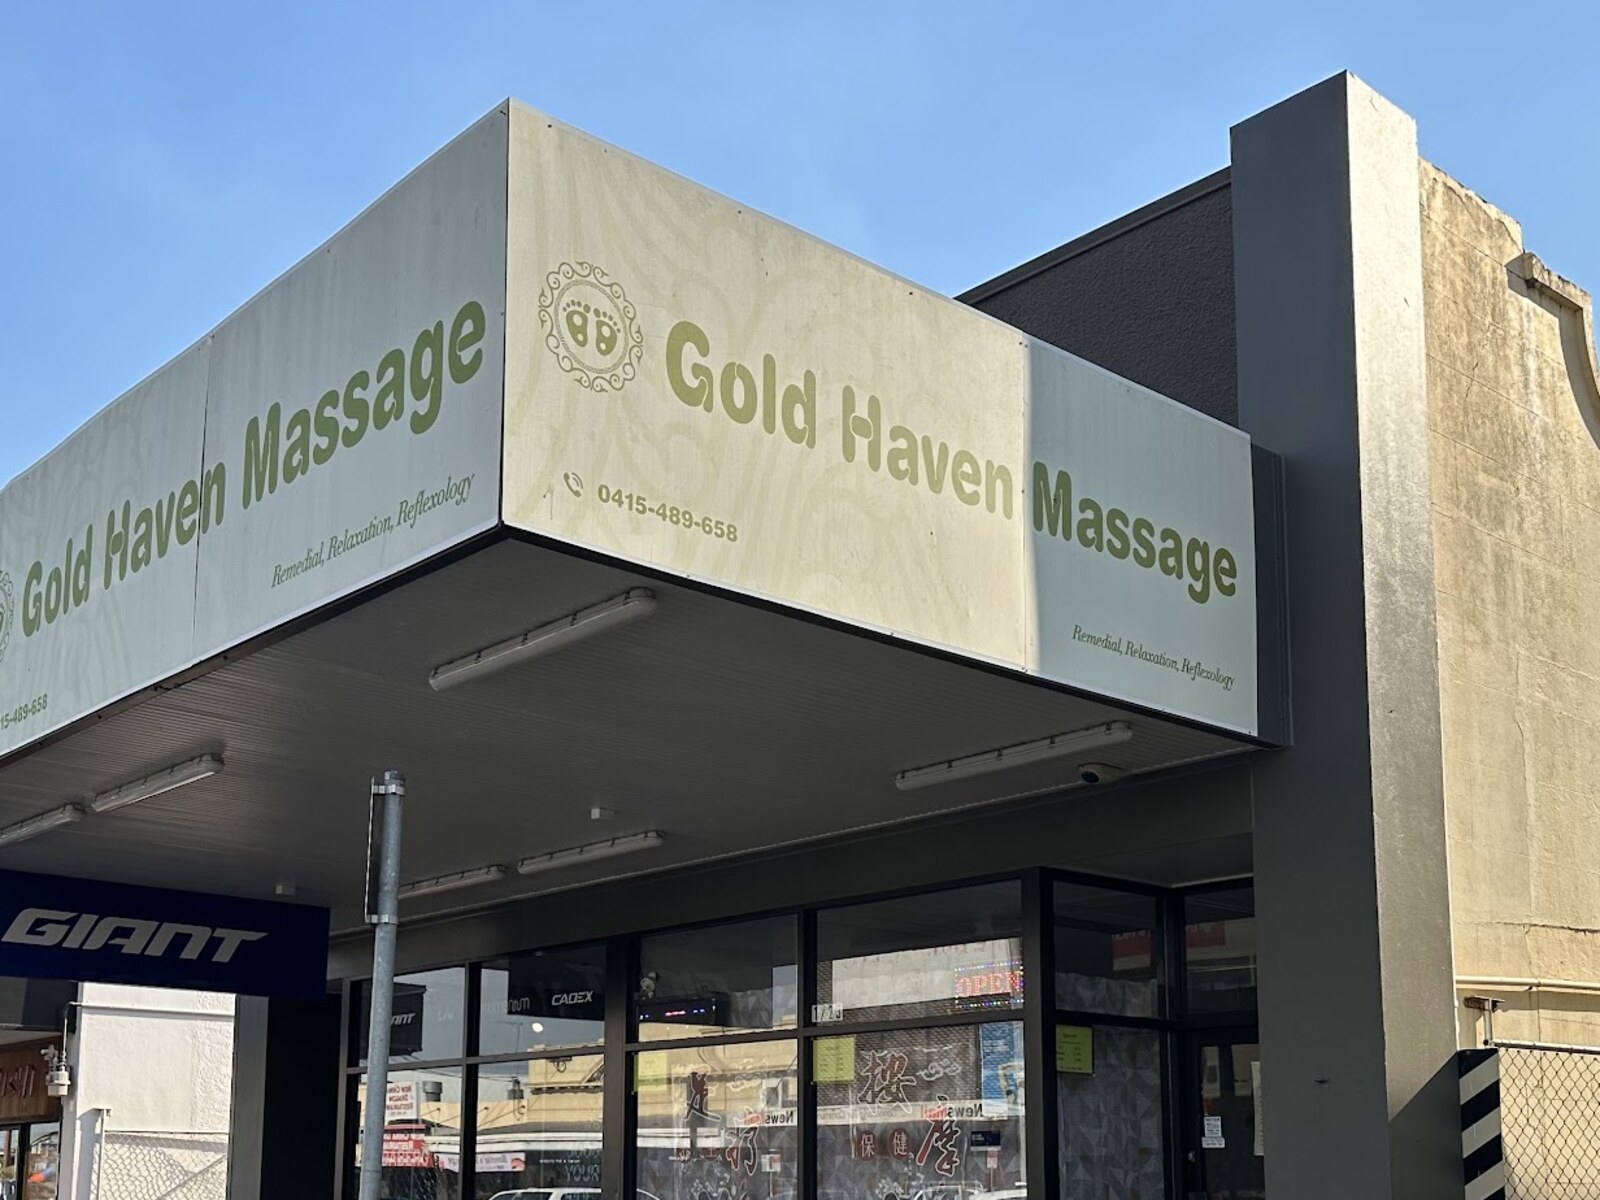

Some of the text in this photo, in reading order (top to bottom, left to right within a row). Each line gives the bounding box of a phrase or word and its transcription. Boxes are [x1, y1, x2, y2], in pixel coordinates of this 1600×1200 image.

[22, 300, 487, 637] Gold Haven Massage
[665, 320, 1238, 605] Gold Haven Massage
[271, 473, 476, 588] Remedial, Relaxation, Reflexology
[597, 483, 739, 543] 0415-489-658
[1071, 624, 1235, 691] Remedial, Relaxation, Reflexology
[1, 907, 268, 963] GIANT
[551, 990, 594, 1006] CADEX
[957, 971, 1022, 998] OPEN
[391, 1012, 416, 1025] ANT
